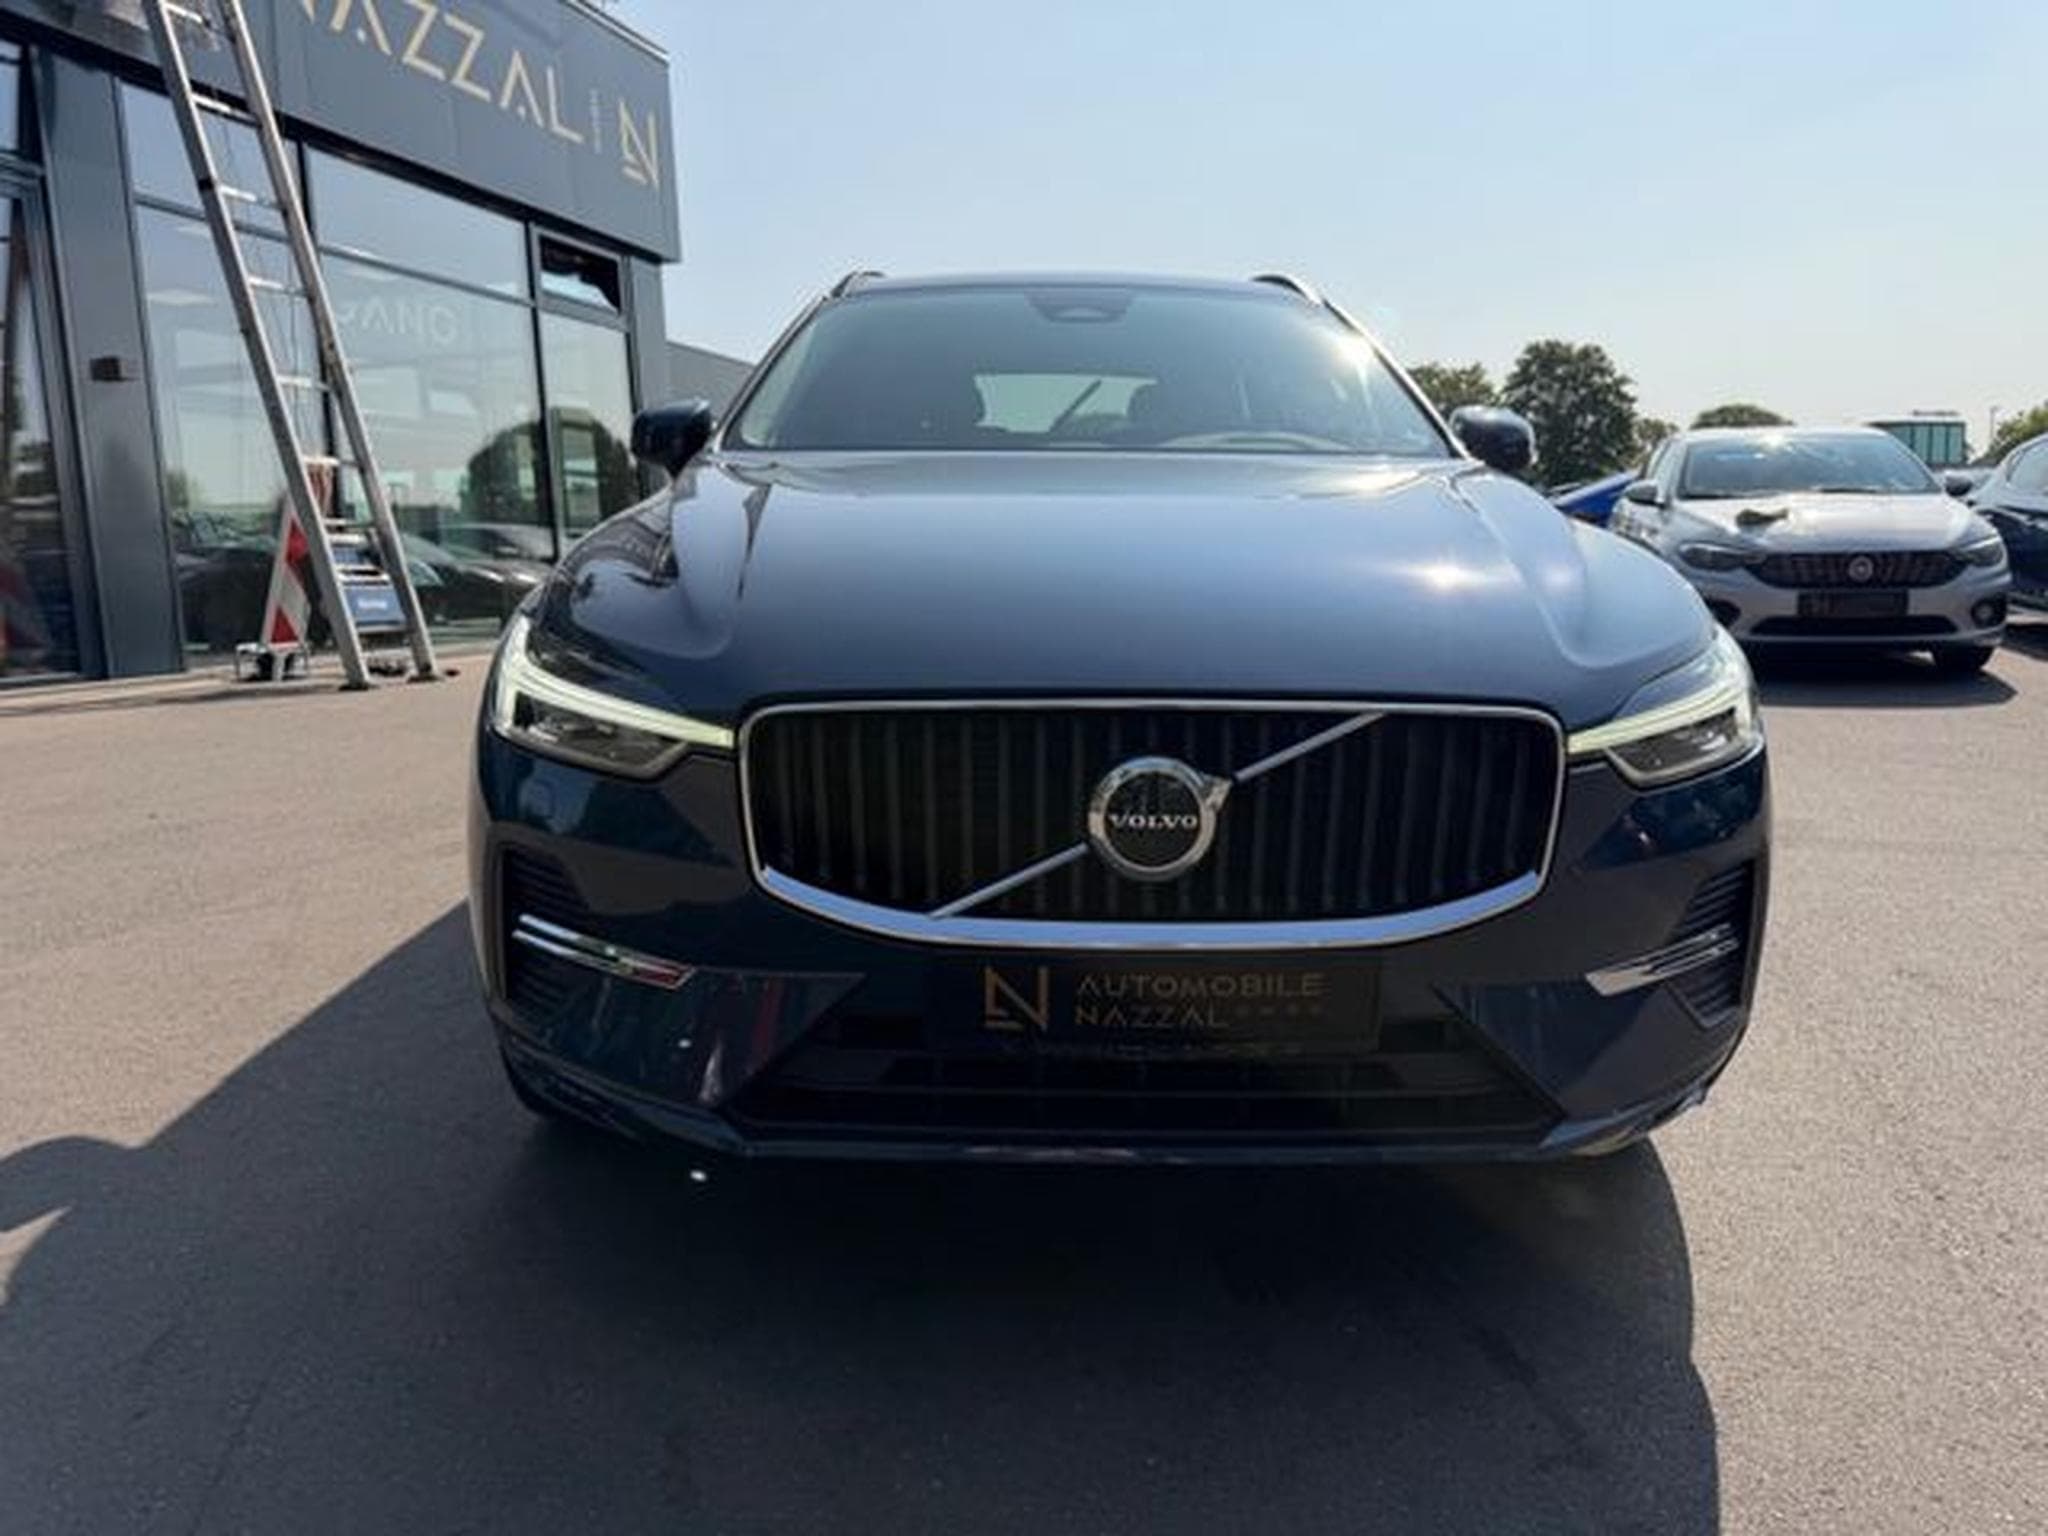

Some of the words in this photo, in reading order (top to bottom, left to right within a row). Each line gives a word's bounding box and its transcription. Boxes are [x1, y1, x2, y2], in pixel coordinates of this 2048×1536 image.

[1109, 814, 1199, 830] VOLVO
[1076, 971, 1326, 999] AUTOMOBILE
[1074, 1005, 1229, 1029] NAZZAL
